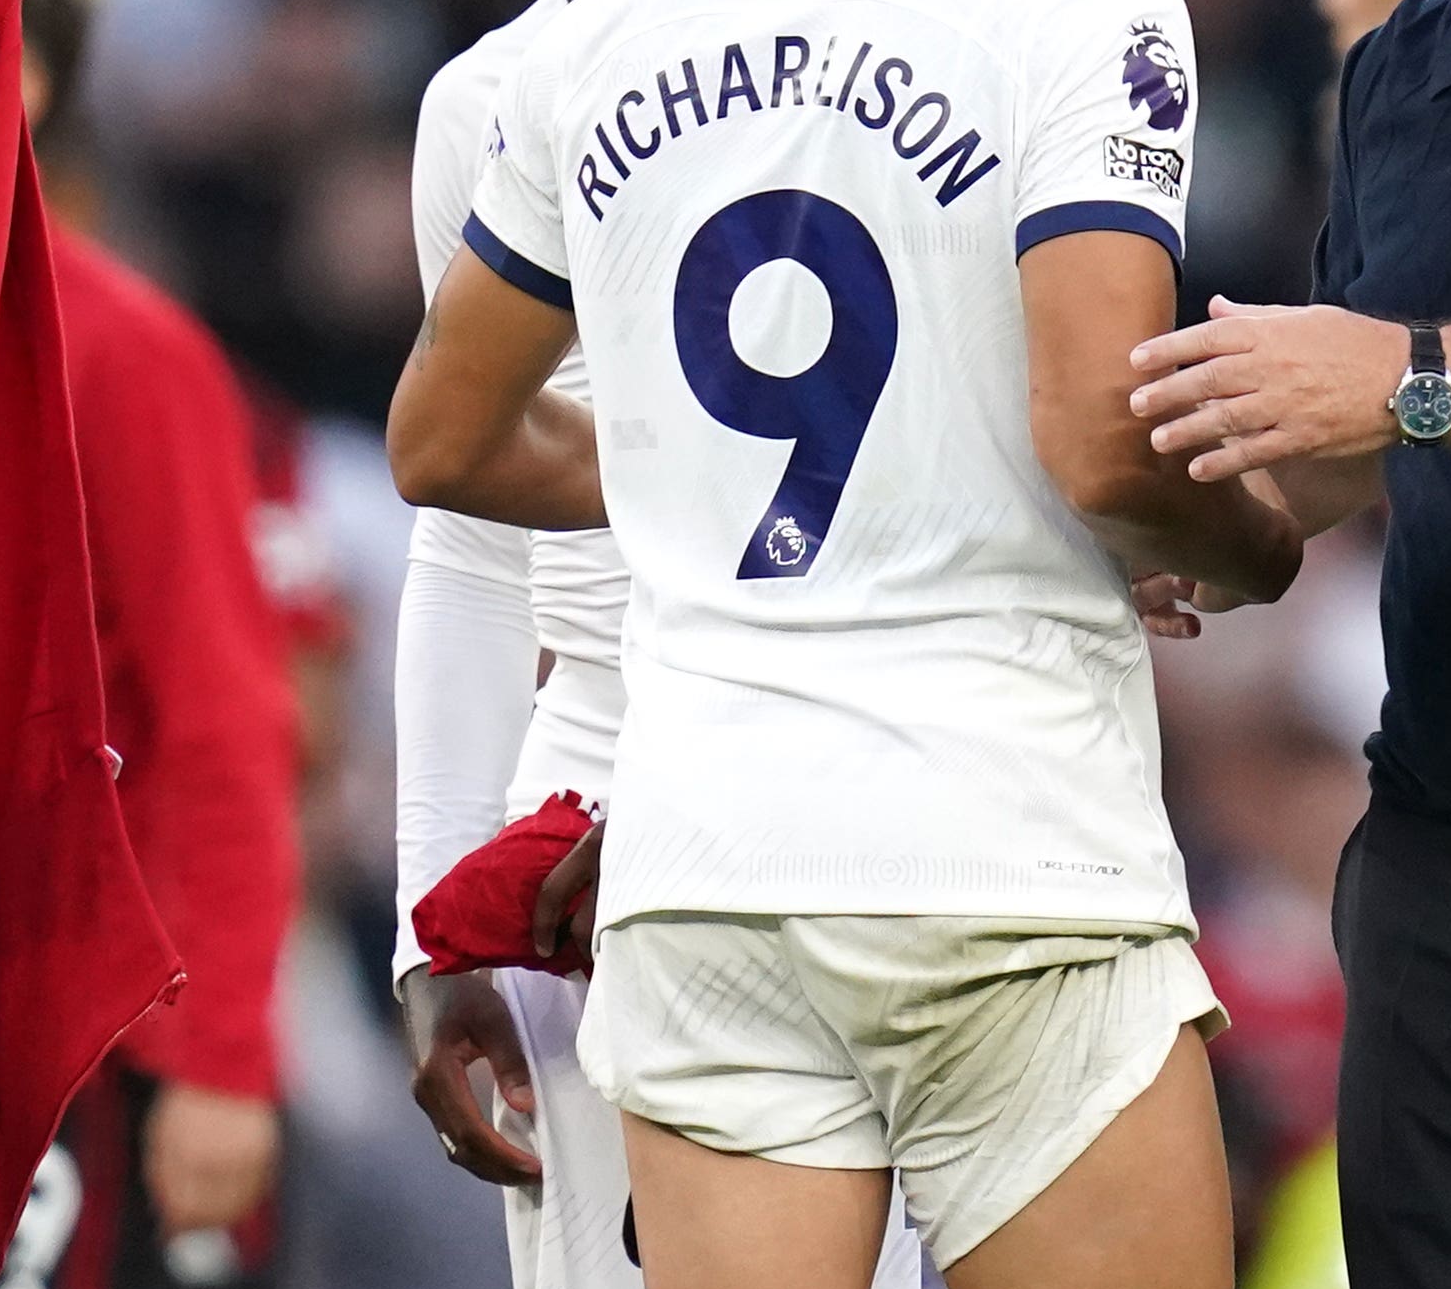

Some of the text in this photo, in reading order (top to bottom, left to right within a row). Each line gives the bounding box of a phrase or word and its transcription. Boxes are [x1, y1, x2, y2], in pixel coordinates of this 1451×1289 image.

[577, 35, 1001, 222] RICHARLISON
[1105, 137, 1181, 179] No room
[674, 189, 898, 580] 9
